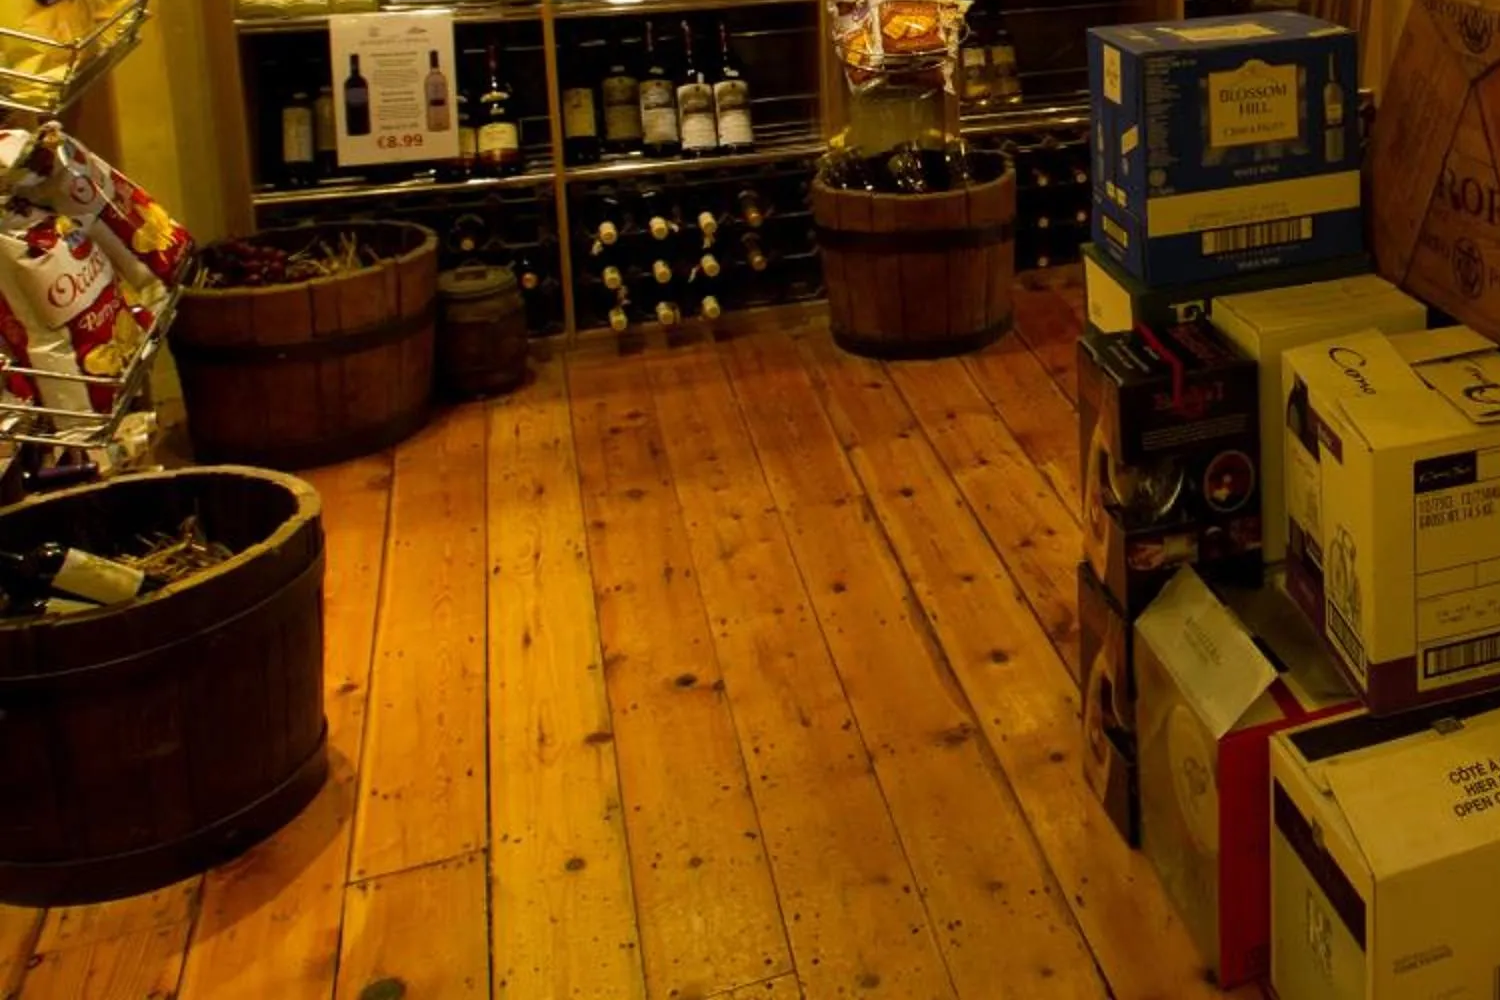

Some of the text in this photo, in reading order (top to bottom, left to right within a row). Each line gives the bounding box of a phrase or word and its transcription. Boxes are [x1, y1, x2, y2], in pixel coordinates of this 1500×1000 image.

[1218, 83, 1288, 104] BLOSSOM
[1238, 101, 1274, 119] HILL
[1463, 776, 1499, 797] HIER
[1453, 795, 1494, 817] OPEN
